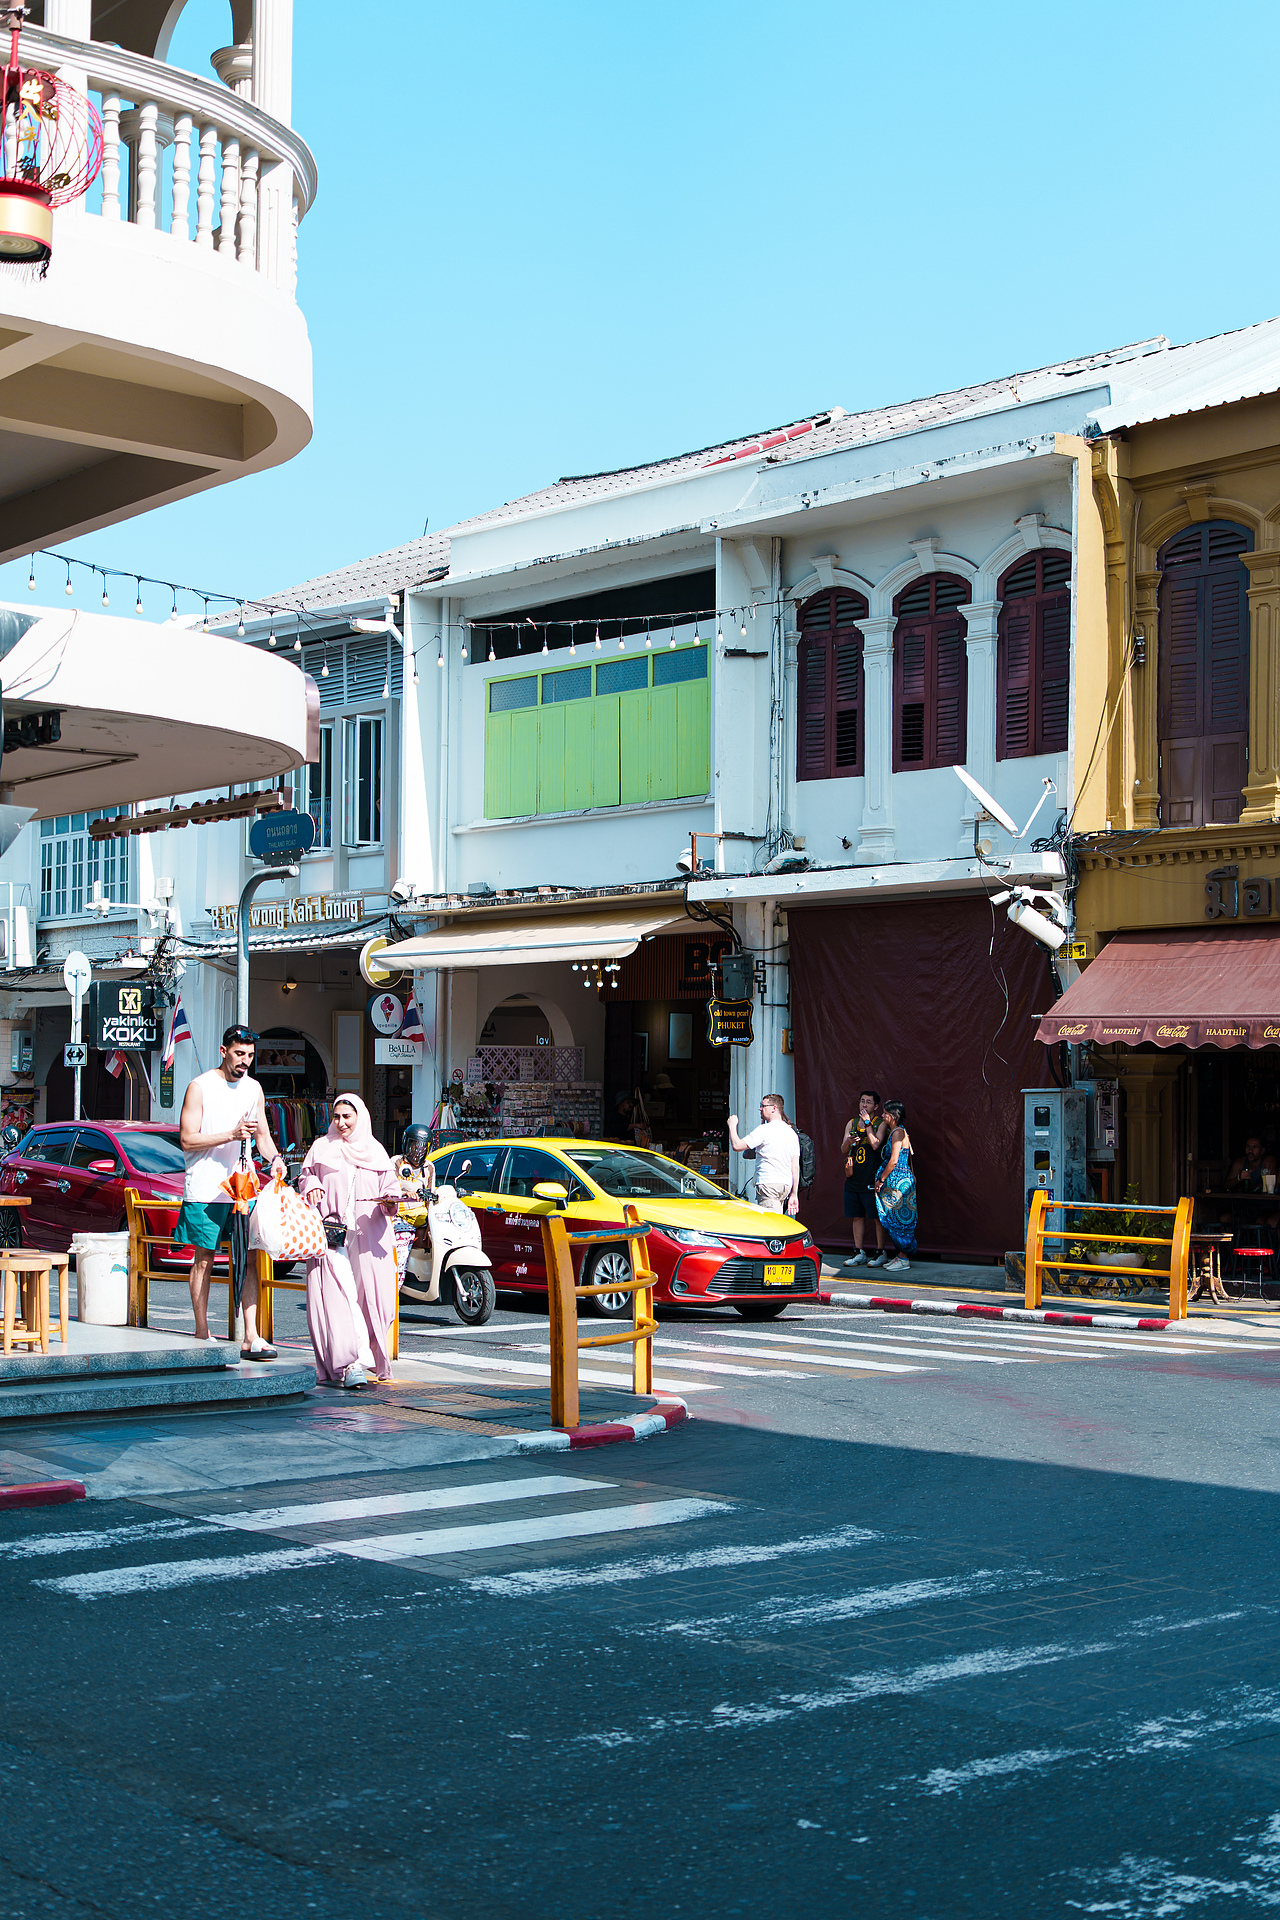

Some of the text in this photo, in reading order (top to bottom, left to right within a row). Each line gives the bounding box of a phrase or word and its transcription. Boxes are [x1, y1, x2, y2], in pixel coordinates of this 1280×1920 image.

[268, 839, 297, 849] THALANG ROAD
[1205, 865, 1280, 918] มือ
[249, 905, 284, 930] wong
[288, 896, 313, 923] Kah
[318, 895, 359, 923] Loong
[713, 1009, 723, 1017] old
[102, 1015, 157, 1028] yakiniku
[717, 1021, 745, 1030] PHUKET
[102, 1027, 157, 1042] KOKU
[855, 1146, 866, 1164] 8
[524, 1245, 533, 1253] 779
[781, 1266, 792, 1275] 779
